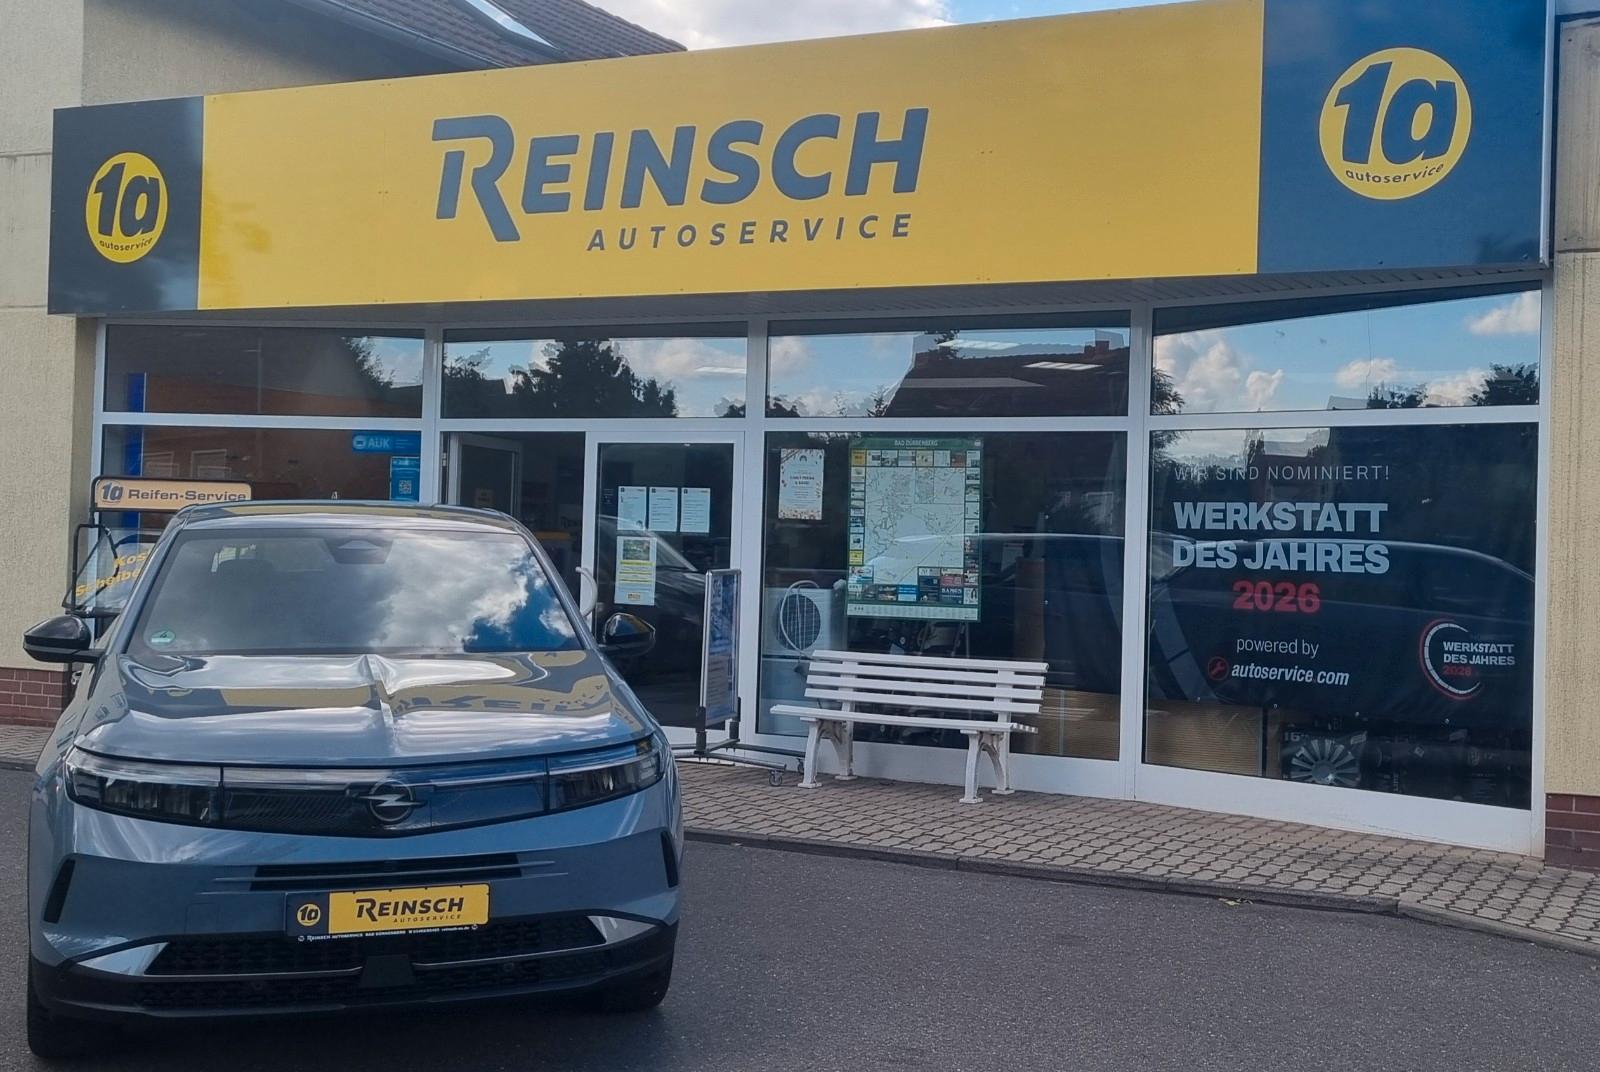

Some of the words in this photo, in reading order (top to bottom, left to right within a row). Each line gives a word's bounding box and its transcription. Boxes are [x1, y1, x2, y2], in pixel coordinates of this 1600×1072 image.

[1334, 61, 1458, 165] 1a
[431, 107, 930, 243] REINSCH
[1345, 163, 1444, 184] autoservice
[94, 162, 160, 237] 1a
[99, 237, 154, 252] autoservice
[586, 213, 912, 252] AUTOSERVICE
[1174, 465, 1209, 481] WIR
[1215, 465, 1260, 481] SIND
[1268, 465, 1390, 481] NOMINIERT!
[128, 488, 247, 501] Reifen-Service
[1173, 501, 1389, 533] WERKSTATT
[1172, 540, 1237, 569] DES
[1244, 542, 1390, 575] JAHRES
[1233, 580, 1321, 614] 2026
[1236, 638, 1298, 655] powered
[1302, 641, 1320, 657] by
[1443, 641, 1515, 654] WERKSTATT
[1443, 653, 1468, 665] DES
[1469, 654, 1516, 666] JAHRES
[1231, 661, 1350, 687] autoservice.com
[356, 897, 465, 922] REINSCH
[393, 913, 462, 924] AUTOSERVICE
